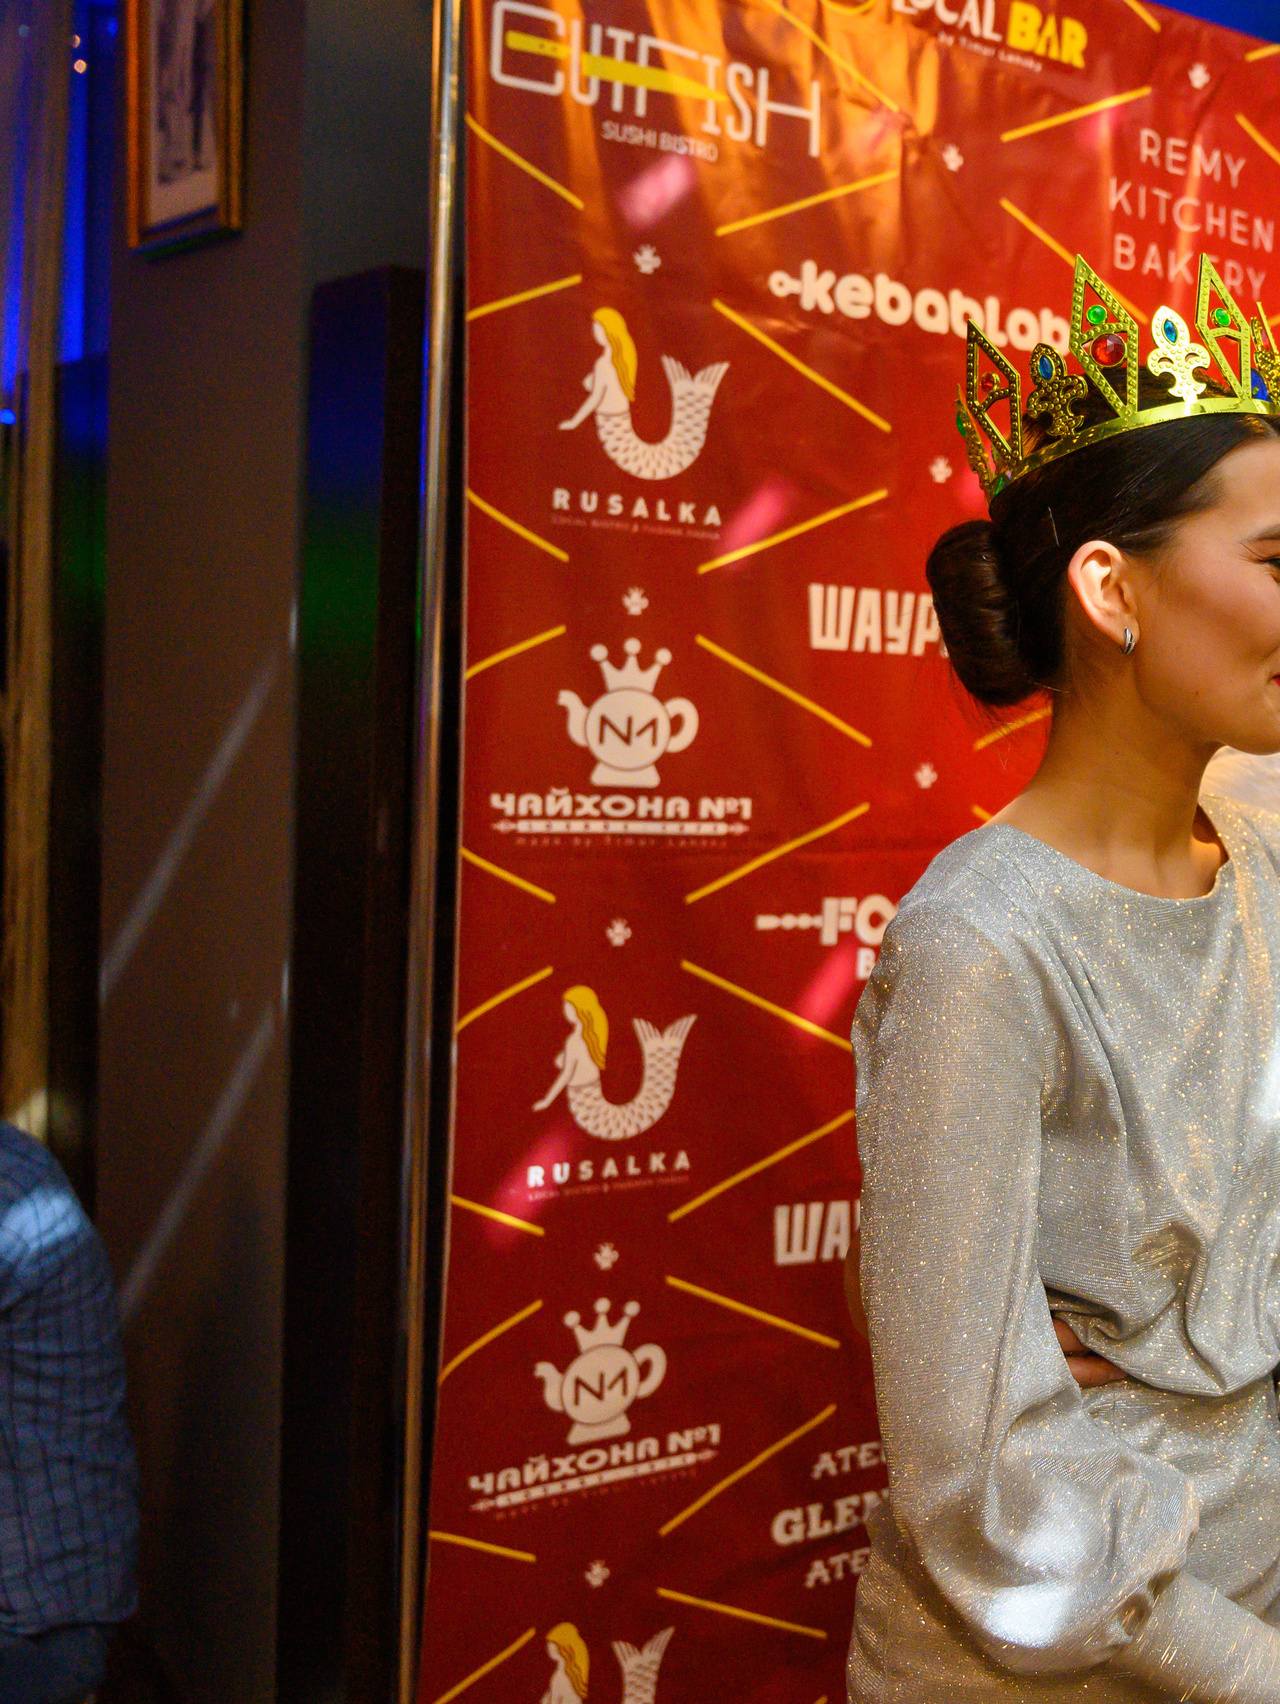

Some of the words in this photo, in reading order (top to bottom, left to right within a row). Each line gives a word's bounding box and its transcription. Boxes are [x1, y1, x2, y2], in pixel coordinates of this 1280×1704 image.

[1007, 1, 1088, 69] BAR
[601, 120, 657, 148] SUSHI
[659, 131, 719, 162] BISTRO
[1139, 127, 1247, 189] REMY
[1109, 176, 1275, 254] KITCHEN
[552, 487, 722, 527] RUSALKA
[808, 582, 950, 658] ШАУР
[490, 787, 690, 819] ЧАЙХОНА
[527, 1150, 691, 1187] RUSALKA
[468, 1437, 660, 1495] ЧАЙХОНА
